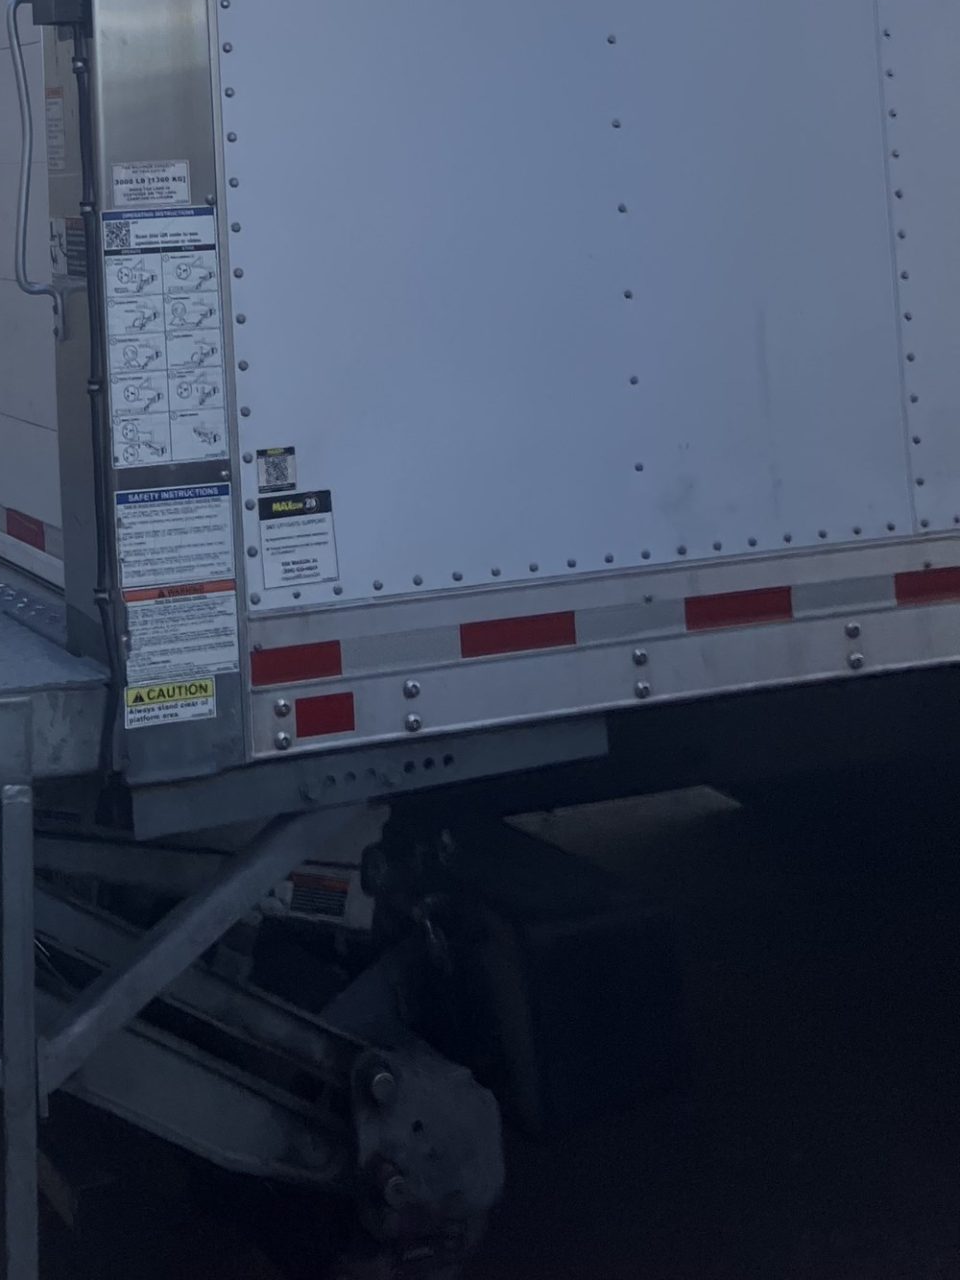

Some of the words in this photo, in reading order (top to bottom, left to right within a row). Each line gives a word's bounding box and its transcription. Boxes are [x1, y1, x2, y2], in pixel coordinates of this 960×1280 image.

[114, 178, 133, 186] 3000
[128, 493, 158, 502] SAFETY
[160, 487, 219, 499] INSTRUCTIONS
[147, 683, 208, 701] CAUTION
[128, 706, 155, 716] Always
[157, 704, 178, 712] stand
[129, 713, 161, 724] platform
[162, 711, 179, 719] area
